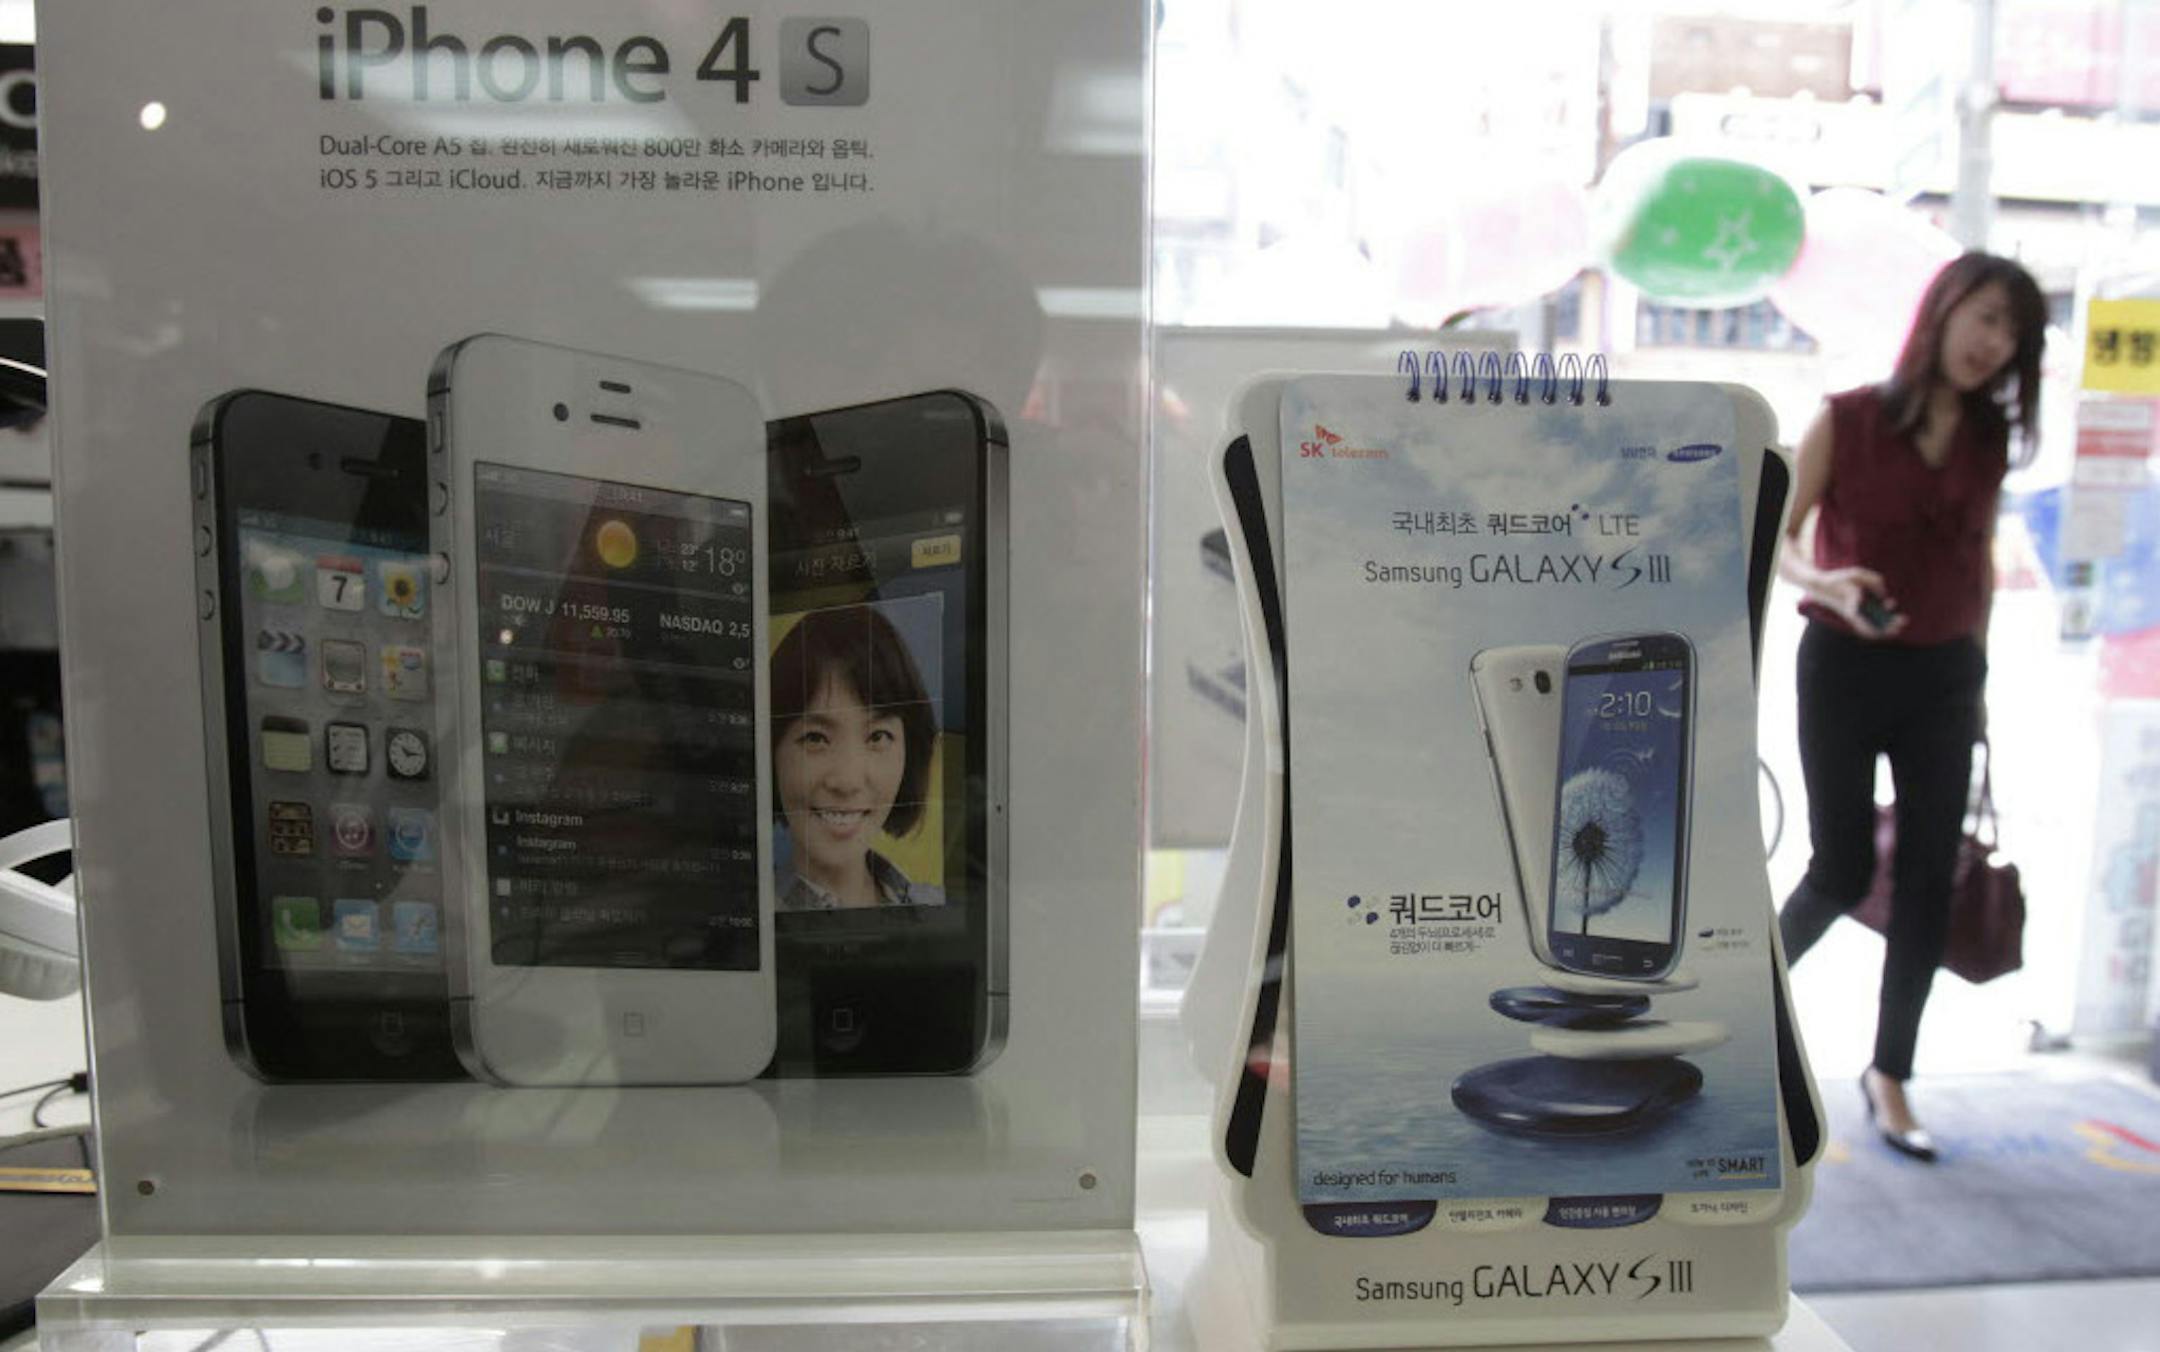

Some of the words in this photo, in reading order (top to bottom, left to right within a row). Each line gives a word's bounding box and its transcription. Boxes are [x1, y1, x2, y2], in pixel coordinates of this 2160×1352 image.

[316, 5, 670, 101] iPhone
[697, 17, 760, 104] 4
[320, 135, 427, 156] Dual-Core
[433, 136, 461, 156] A5
[643, 138, 701, 159] 800만
[708, 138, 746, 159] 화소
[753, 138, 825, 159] 카메라와
[320, 168, 358, 190] iOS
[365, 169, 378, 190] 5
[386, 170, 443, 190] 그리고
[450, 168, 527, 190] iCloud.
[536, 170, 611, 190] 지금까지
[620, 171, 657, 191] 가장
[663, 171, 721, 192] 놀라운
[727, 171, 805, 192] iPhone
[812, 172, 875, 192] 입니다.
[1300, 442, 1324, 458] SK
[1392, 511, 1478, 536] 국내최초
[1487, 513, 1573, 536] 쿼드코어
[1600, 513, 1640, 536] LTE
[1365, 559, 1462, 589] Samsung
[1470, 553, 1602, 584] GALAXY
[1609, 546, 1643, 590] S
[1648, 555, 1671, 583] III
[332, 575, 348, 604] 7
[501, 593, 541, 614] DOW
[659, 613, 723, 635] NASDAQ
[515, 809, 583, 828] Instagram
[516, 835, 577, 853] Instagram
[1389, 892, 1503, 925] 쿼드코어
[1717, 1156, 1768, 1173] SMART
[1313, 1170, 1376, 1189] designed
[1377, 1169, 1399, 1186] for
[1402, 1169, 1457, 1185] humans
[1356, 1276, 1464, 1306] Samsung
[1473, 1262, 1621, 1299] GALAXY
[1628, 1252, 1662, 1299] S
[1669, 1260, 1694, 1293] III
